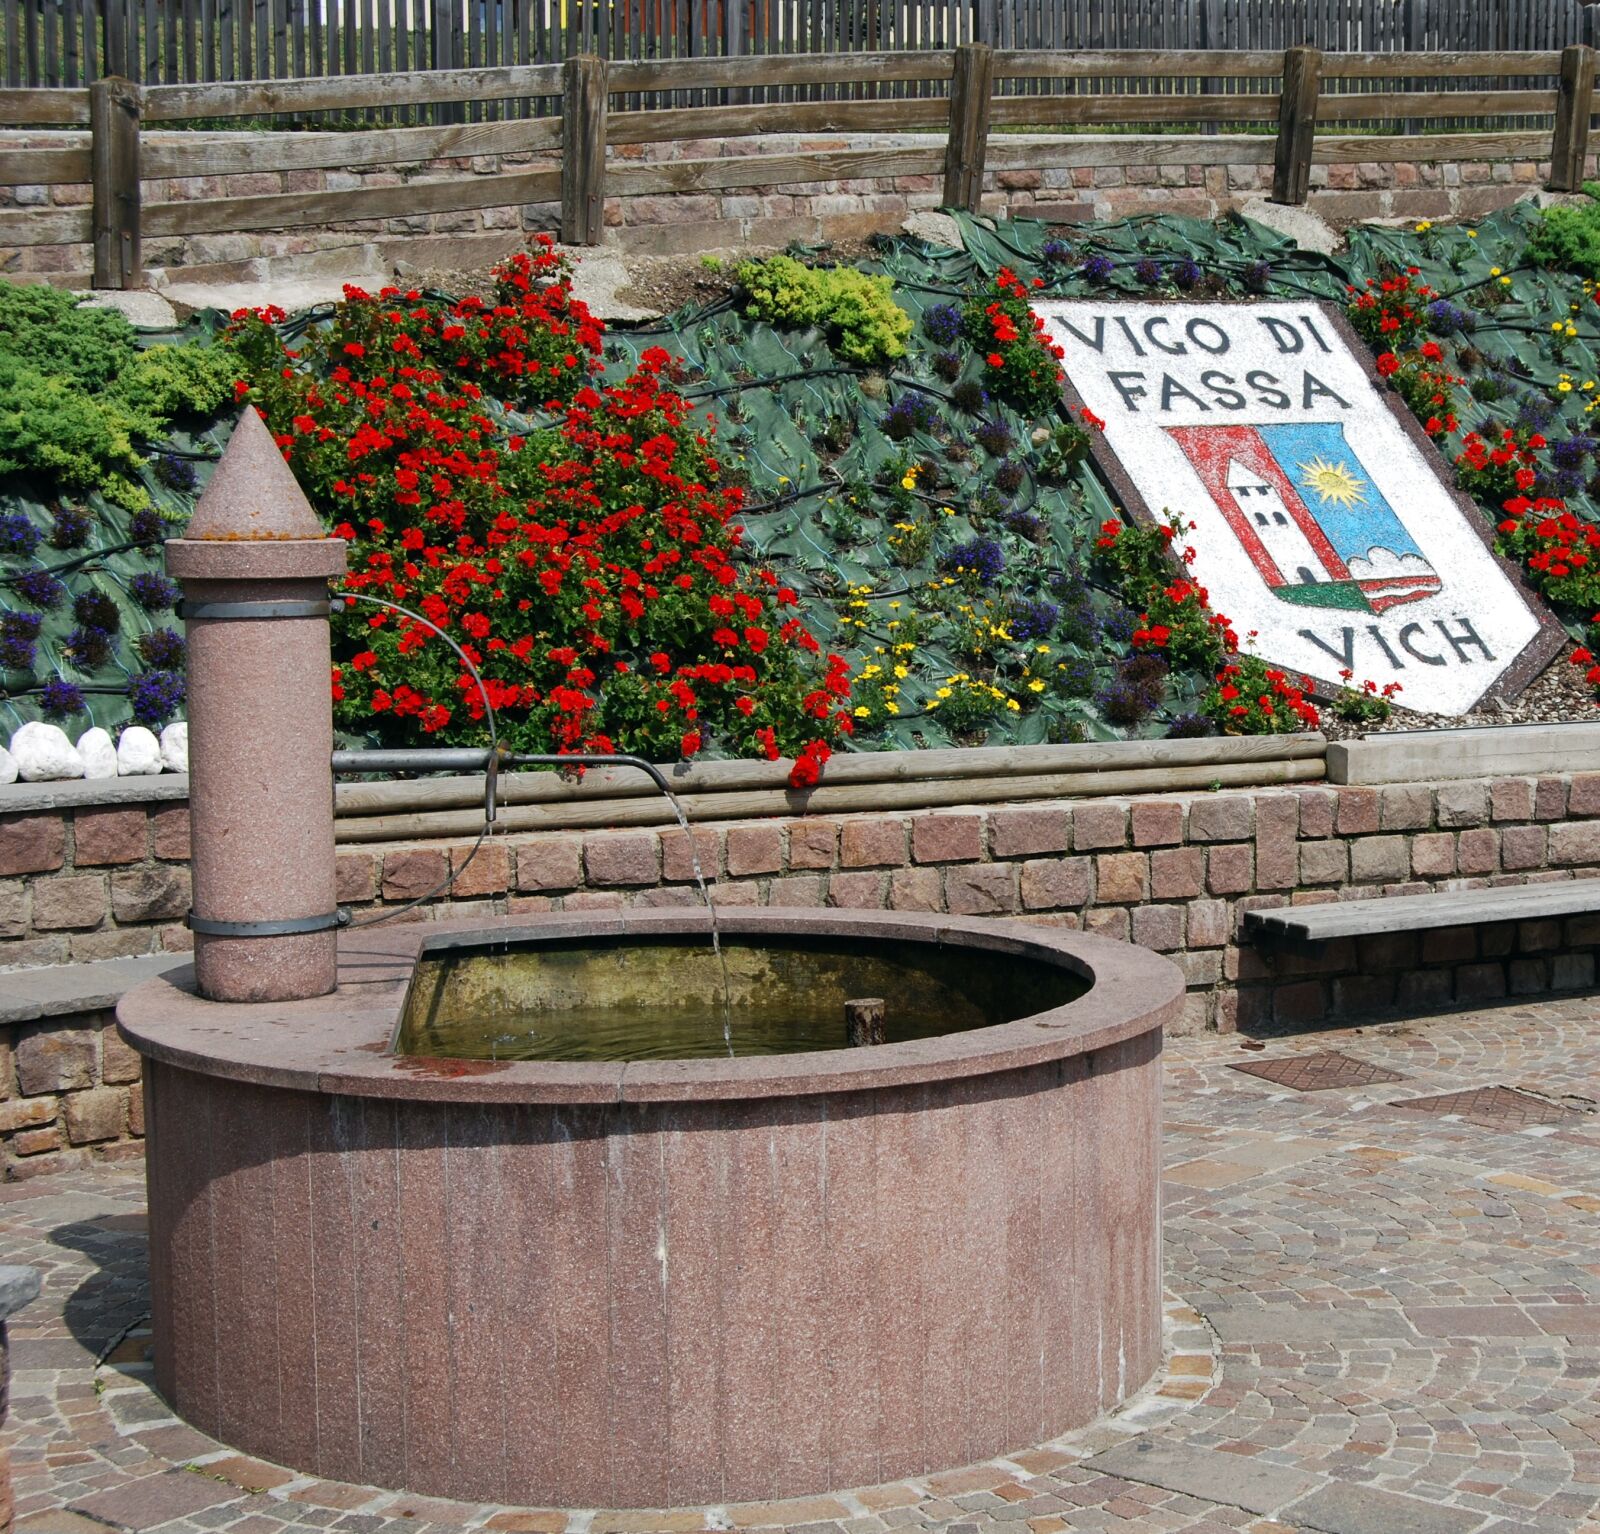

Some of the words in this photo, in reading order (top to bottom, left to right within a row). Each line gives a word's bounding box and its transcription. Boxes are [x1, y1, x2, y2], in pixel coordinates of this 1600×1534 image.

[1053, 315, 1231, 356] VIGO
[1258, 315, 1333, 354] DI
[1106, 368, 1352, 412] FASSA
[1297, 617, 1497, 671] VICH
